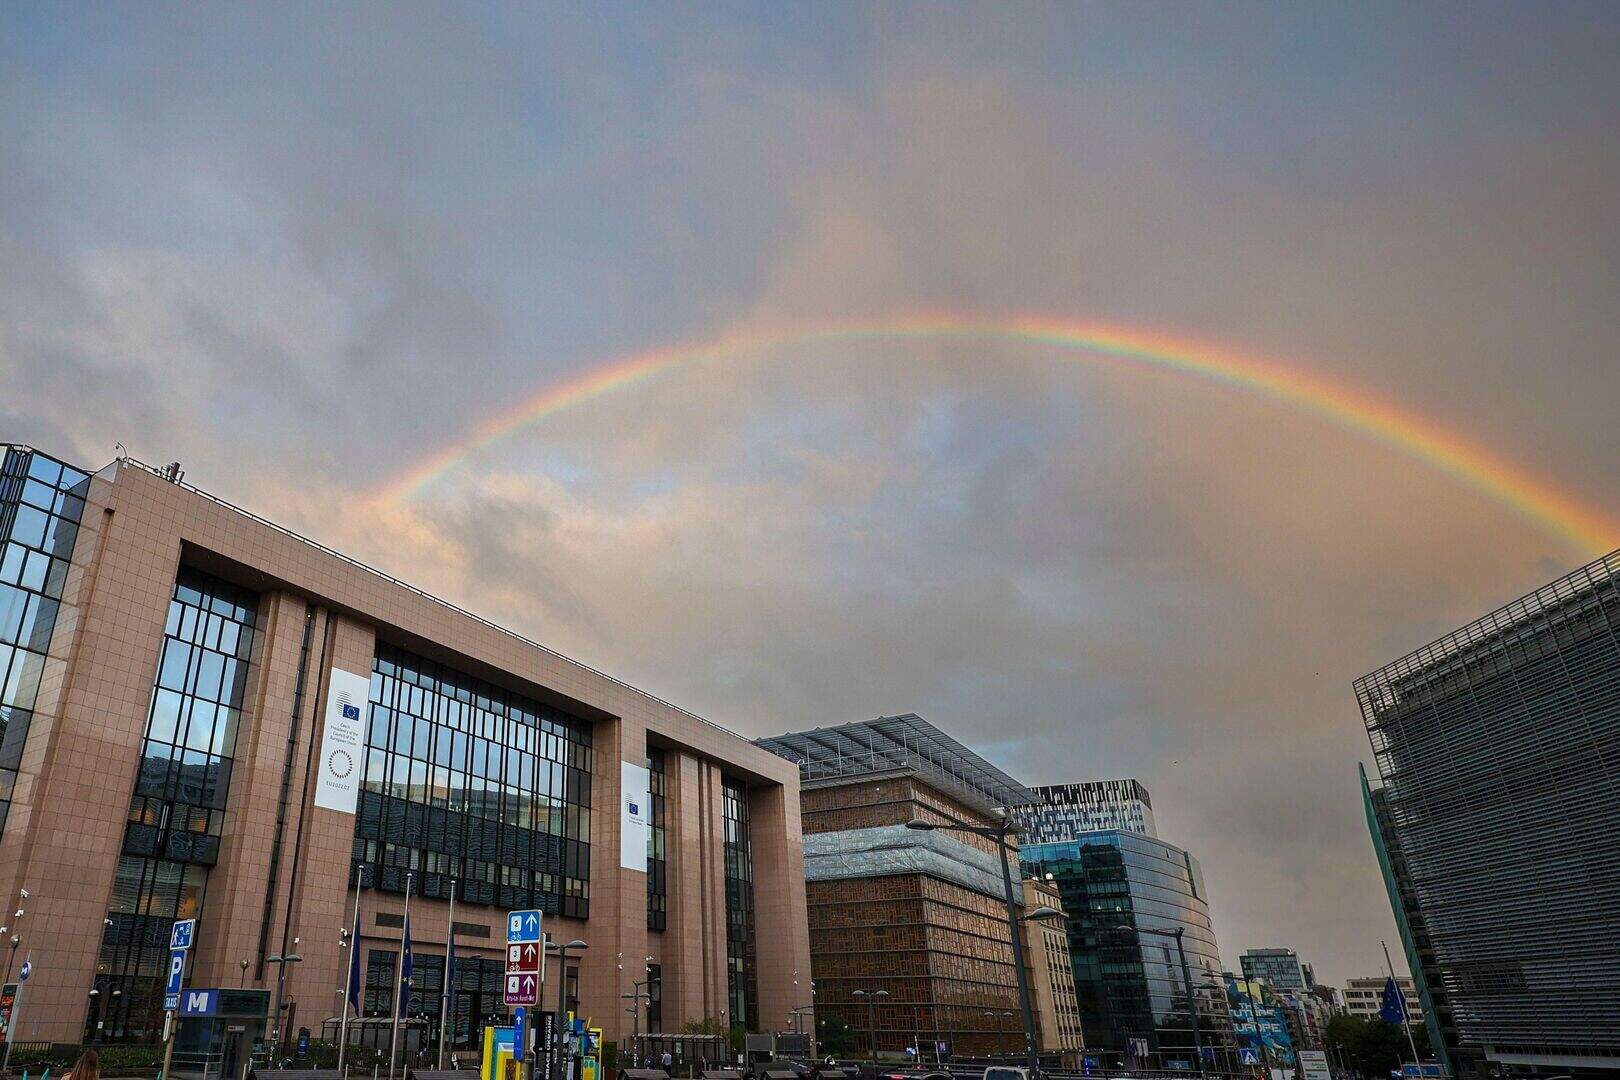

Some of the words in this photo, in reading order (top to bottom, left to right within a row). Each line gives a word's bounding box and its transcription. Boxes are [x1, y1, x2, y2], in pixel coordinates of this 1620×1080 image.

[330, 725, 348, 735] Presidency
[330, 735, 346, 743] European
[326, 780, 350, 790] EU2022CZ
[168, 956, 182, 987] P
[187, 992, 209, 1012] M
